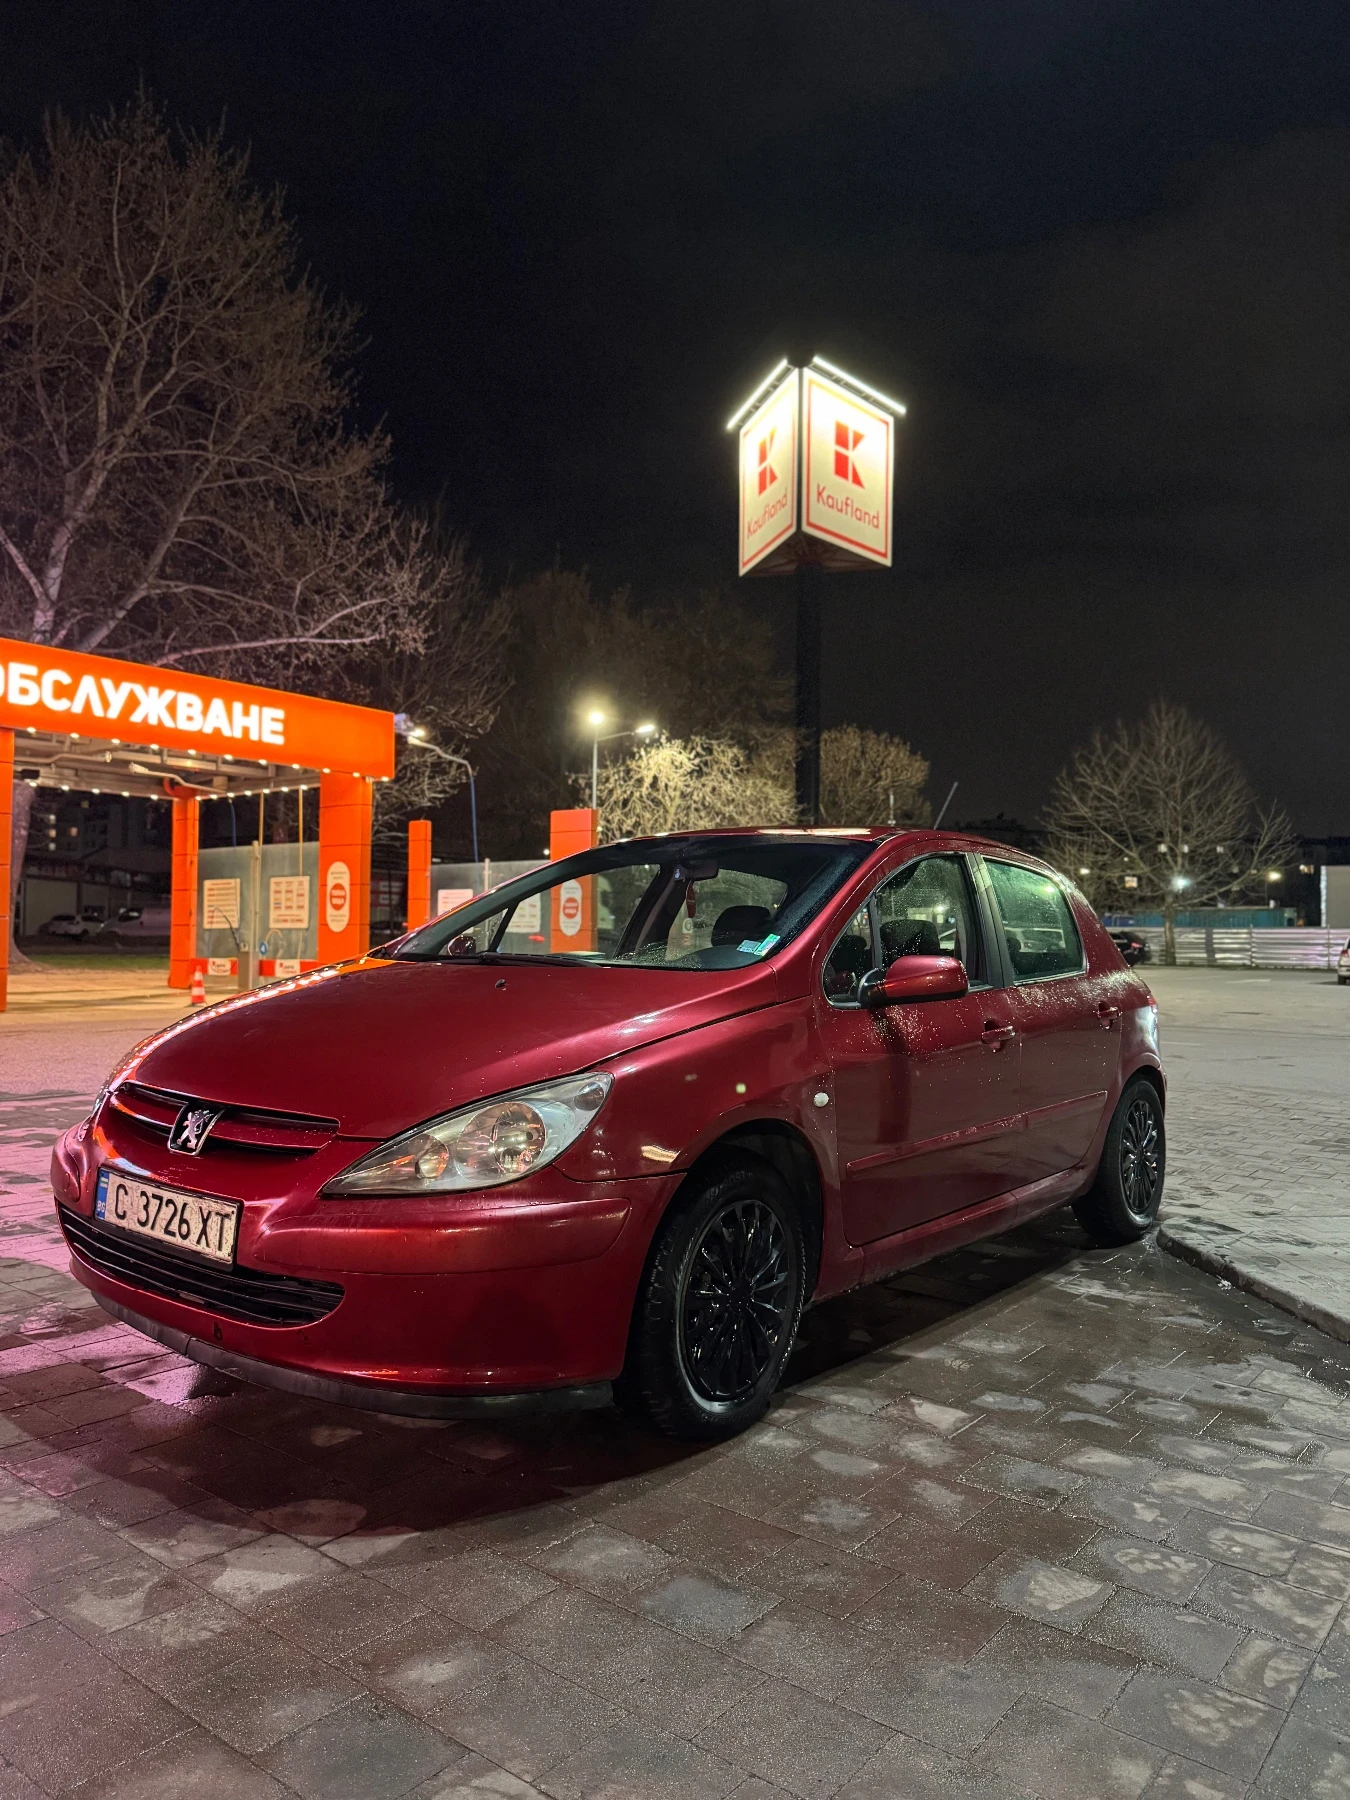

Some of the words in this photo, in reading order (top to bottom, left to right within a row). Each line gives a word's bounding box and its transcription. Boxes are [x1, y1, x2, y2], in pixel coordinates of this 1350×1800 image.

[747, 487, 788, 539] Kaufland
[816, 483, 880, 529] Kaufland
[0, 661, 285, 745] БСЛУЖВАНЕ
[97, 1202, 106, 1213] BG
[115, 1183, 128, 1220] C
[137, 1191, 191, 1240] 3726
[196, 1206, 231, 1251] XT
